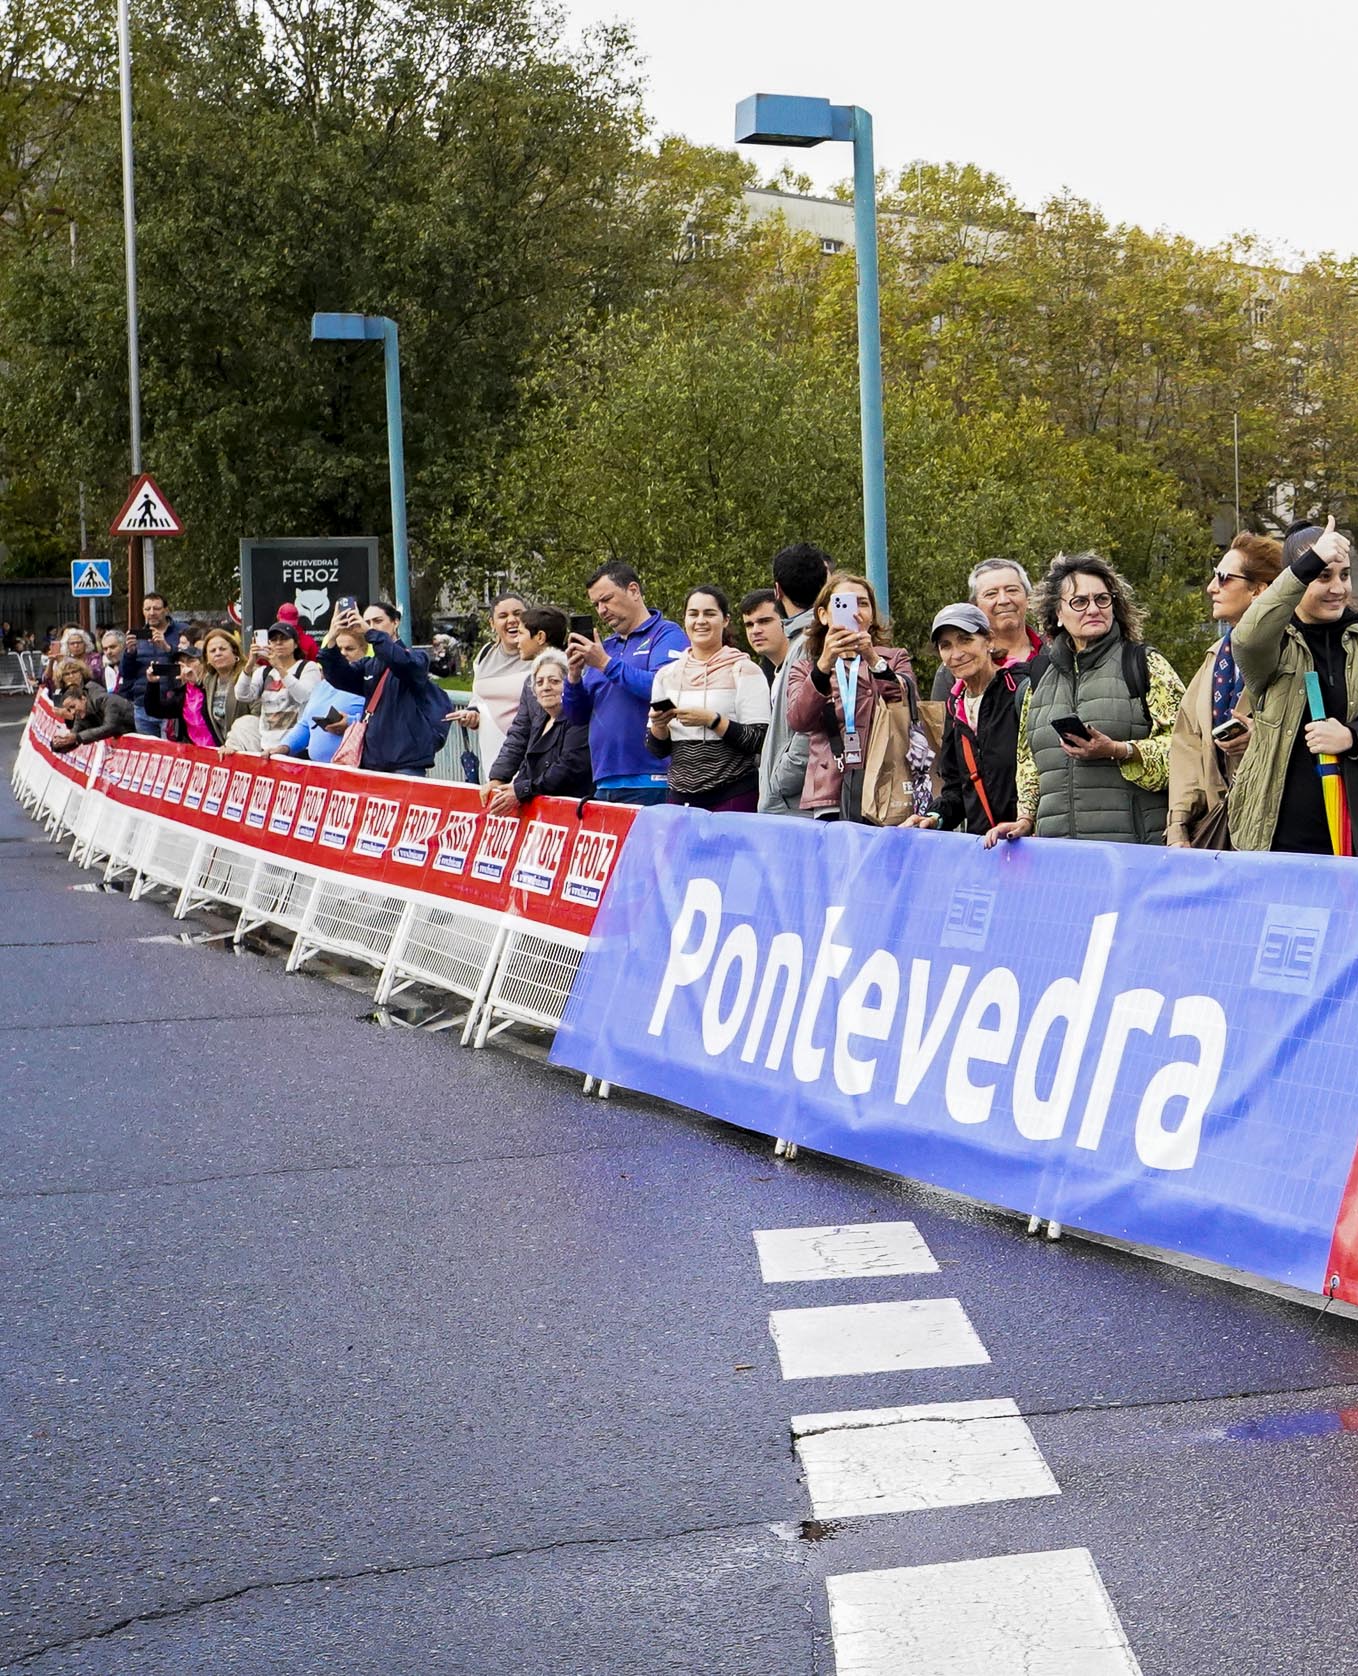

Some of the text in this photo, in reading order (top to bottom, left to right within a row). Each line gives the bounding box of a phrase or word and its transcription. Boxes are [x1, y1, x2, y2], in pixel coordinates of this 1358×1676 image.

[282, 558, 339, 567] PONTEVEDRA É
[283, 568, 339, 583] FEROZ
[326, 794, 357, 829] FROIZ
[361, 801, 398, 838] FROIZ
[401, 808, 438, 845] FROIZ
[479, 817, 518, 860] FROIZ
[518, 824, 565, 871] FROIZ
[570, 834, 616, 882] FROIZ
[648, 877, 1228, 1171] Pontevedra
